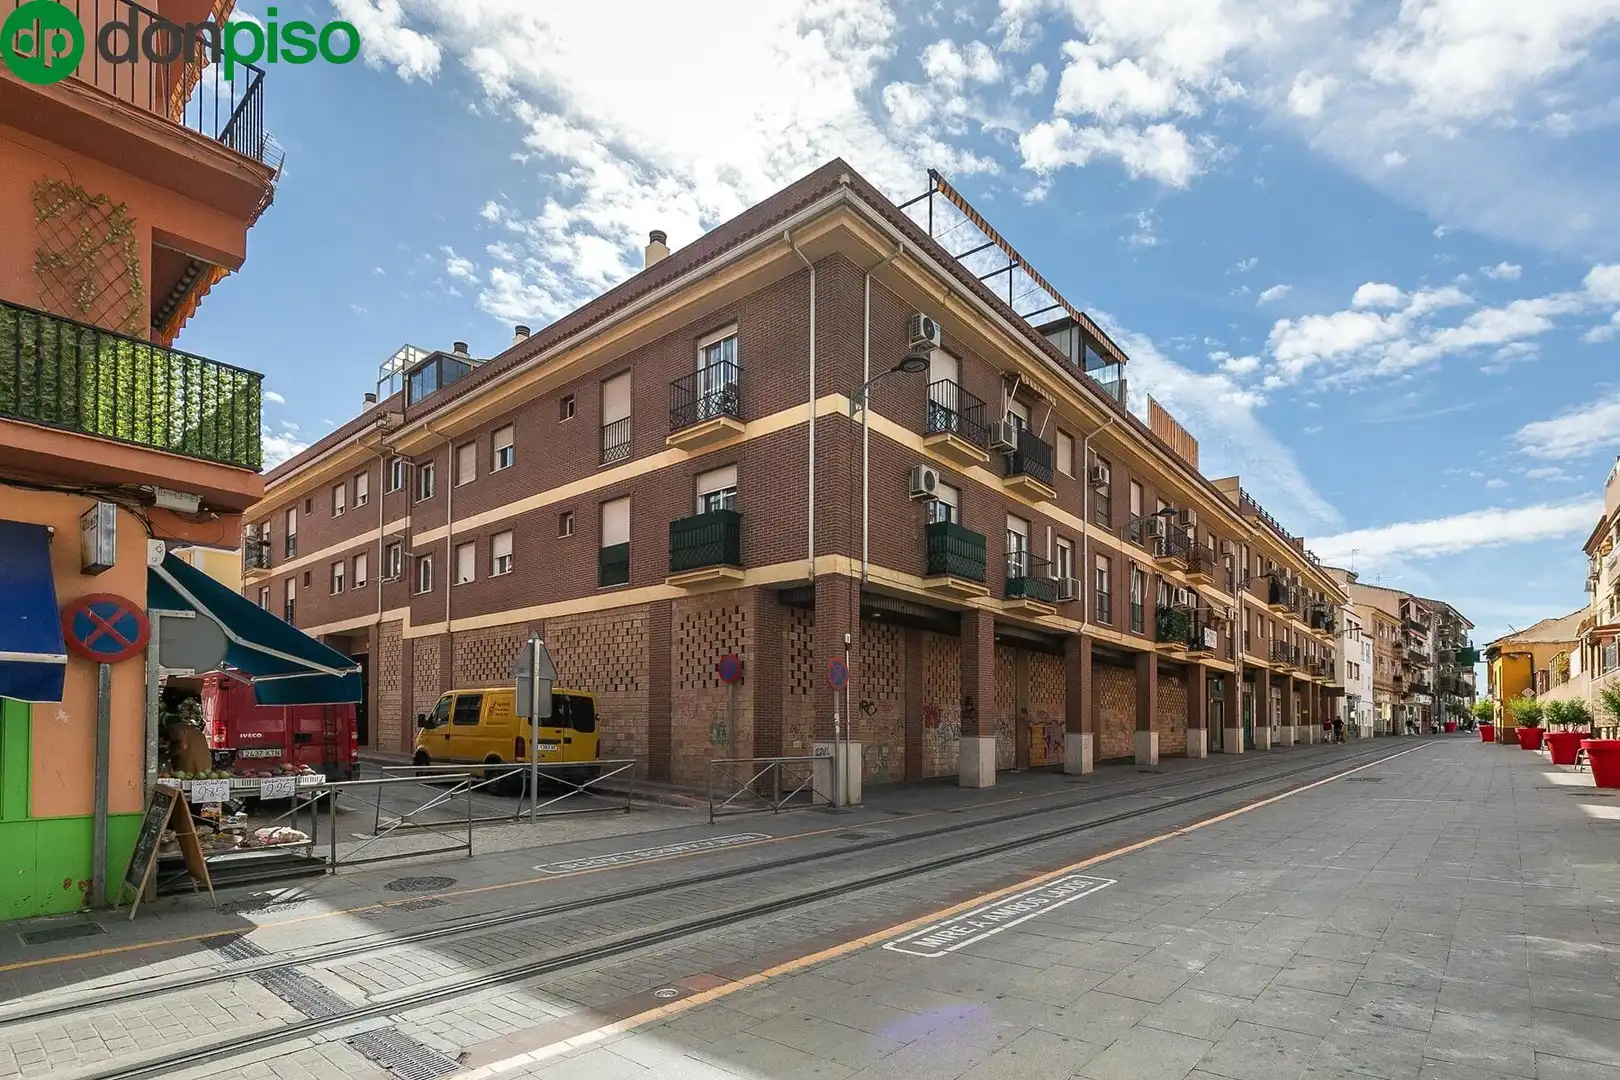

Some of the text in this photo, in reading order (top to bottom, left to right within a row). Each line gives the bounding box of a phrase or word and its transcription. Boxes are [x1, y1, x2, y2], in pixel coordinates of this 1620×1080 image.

[911, 925, 977, 948] MIRE
[982, 896, 1050, 922] AMBOS
[1038, 880, 1094, 899] LADOS
